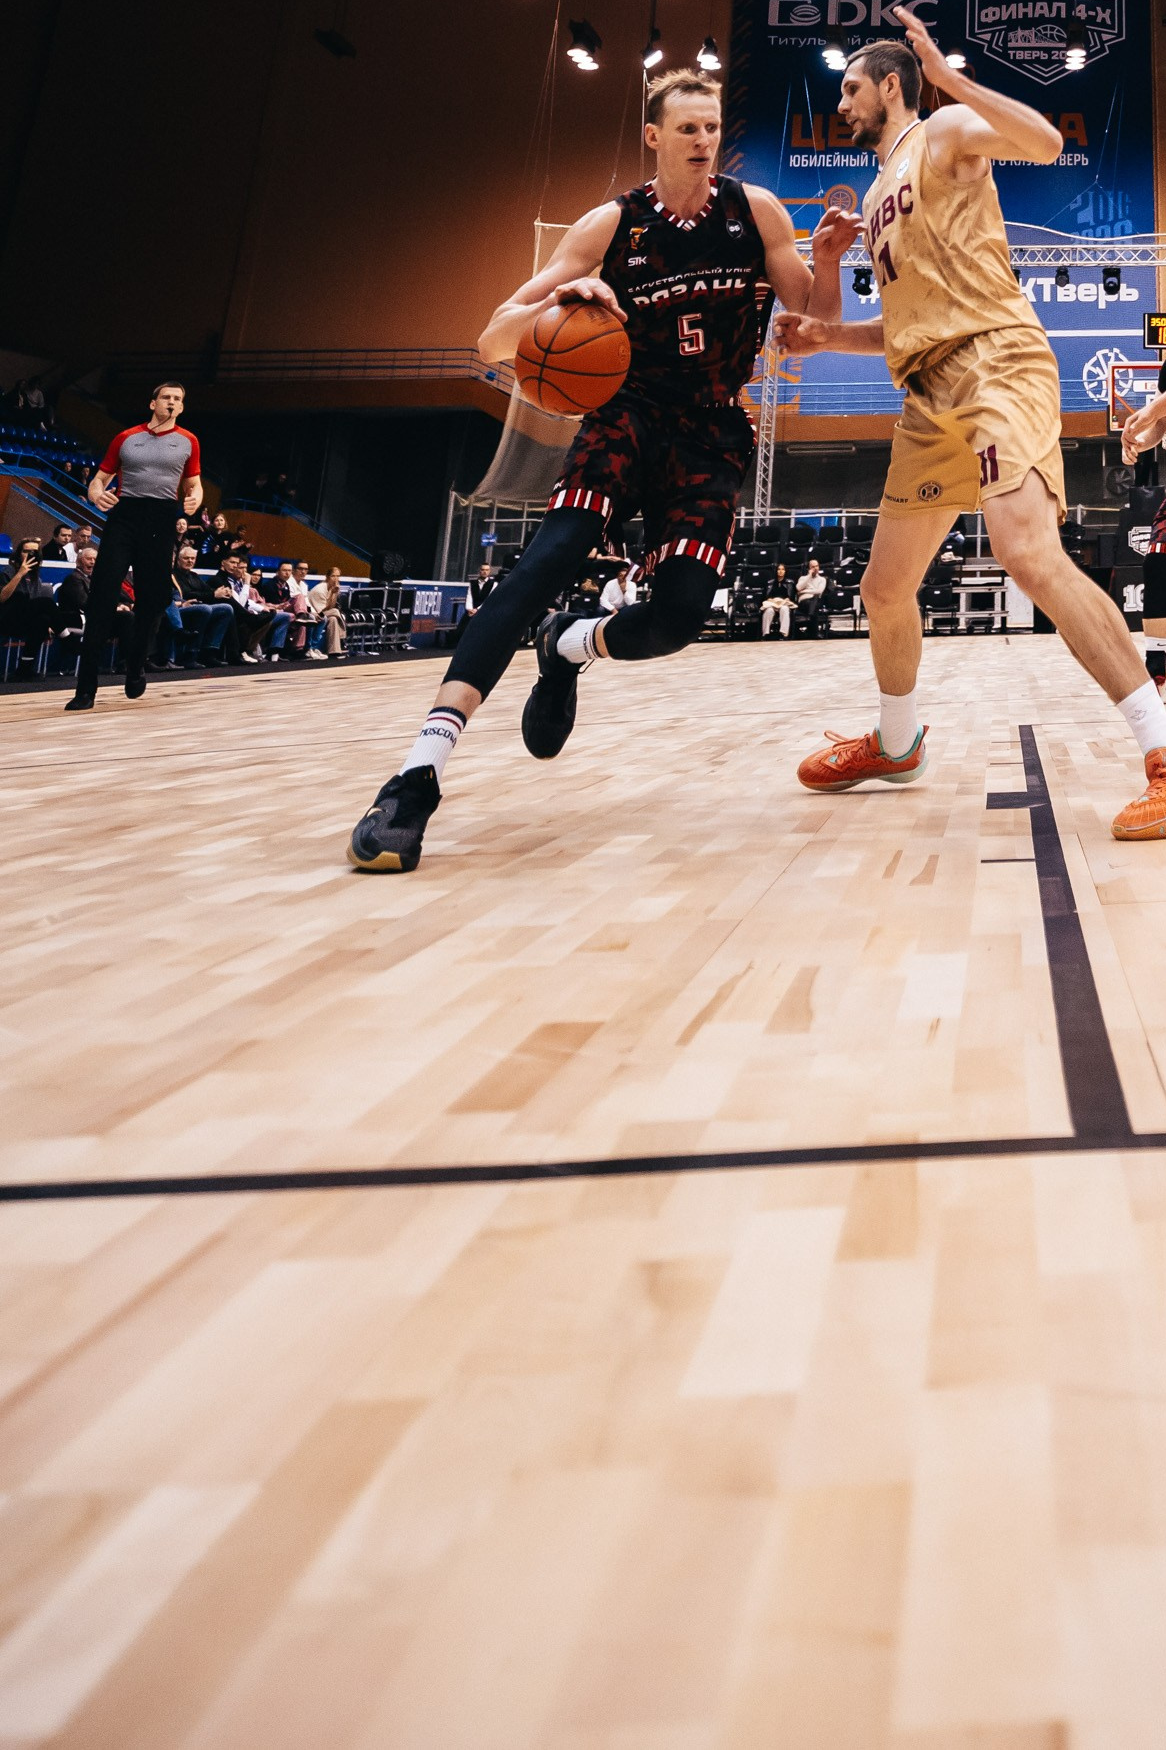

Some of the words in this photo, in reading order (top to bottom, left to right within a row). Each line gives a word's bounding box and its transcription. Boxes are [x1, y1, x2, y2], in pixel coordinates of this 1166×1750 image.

[980, 1, 1066, 23] ФИНАЛ
[768, 35, 861, 48] Титульй
[1008, 50, 1049, 60] ТВЕРЬ
[789, 152, 868, 167] ЮБИЛЕЙНЫЙ
[1054, 153, 1089, 166] ВЕРЬ
[868, 183, 914, 249] ИВС
[677, 313, 705, 356] 5
